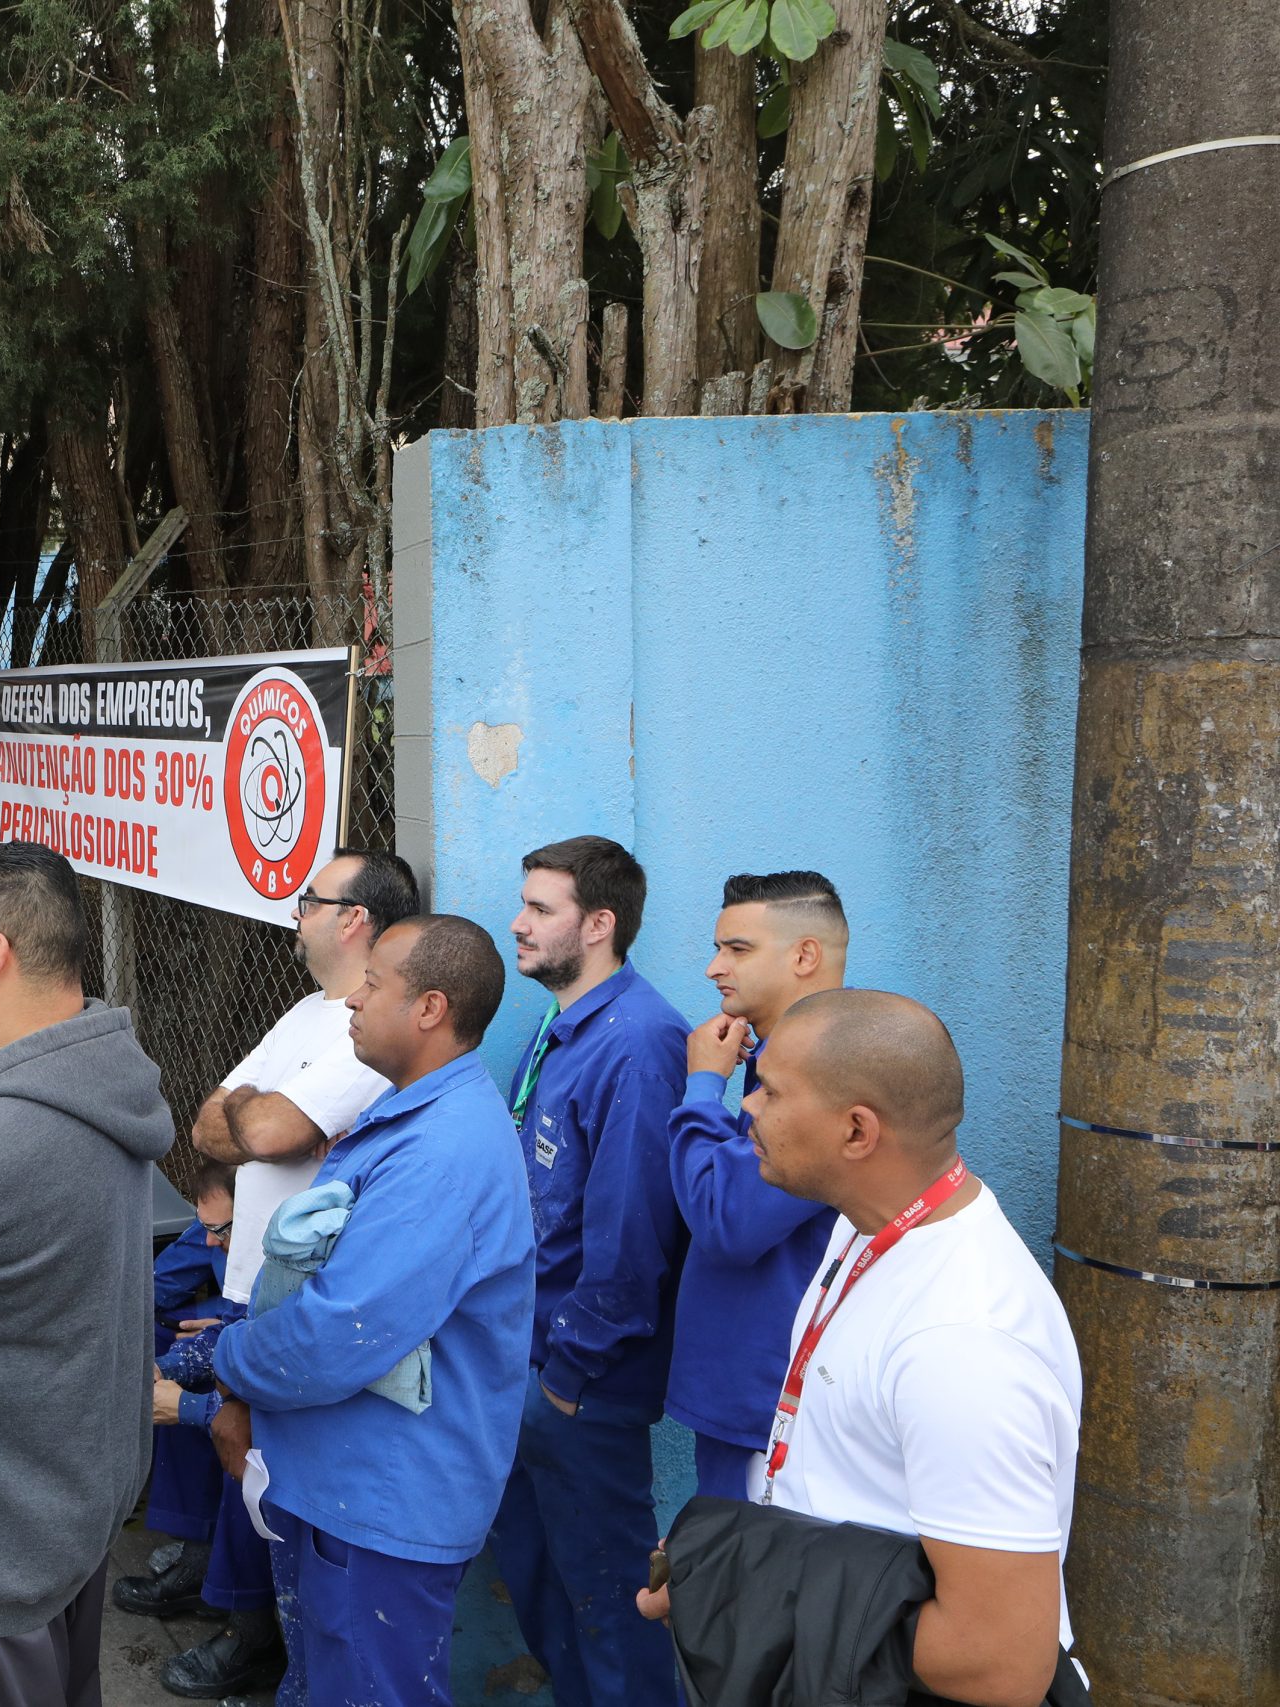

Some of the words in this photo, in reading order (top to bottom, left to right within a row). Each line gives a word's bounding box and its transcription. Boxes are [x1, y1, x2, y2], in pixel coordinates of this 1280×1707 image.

[1, 684, 54, 724] DEFESA
[58, 682, 90, 725] DOS
[96, 678, 211, 738] EMPREGOS,
[240, 686, 308, 740] QUÍMICOS
[104, 748, 145, 802] DOS
[155, 750, 213, 811] 30%
[0, 800, 158, 878] PERICULOSIDADE
[903, 1198, 925, 1219] BASF
[857, 1248, 874, 1269] BASF
